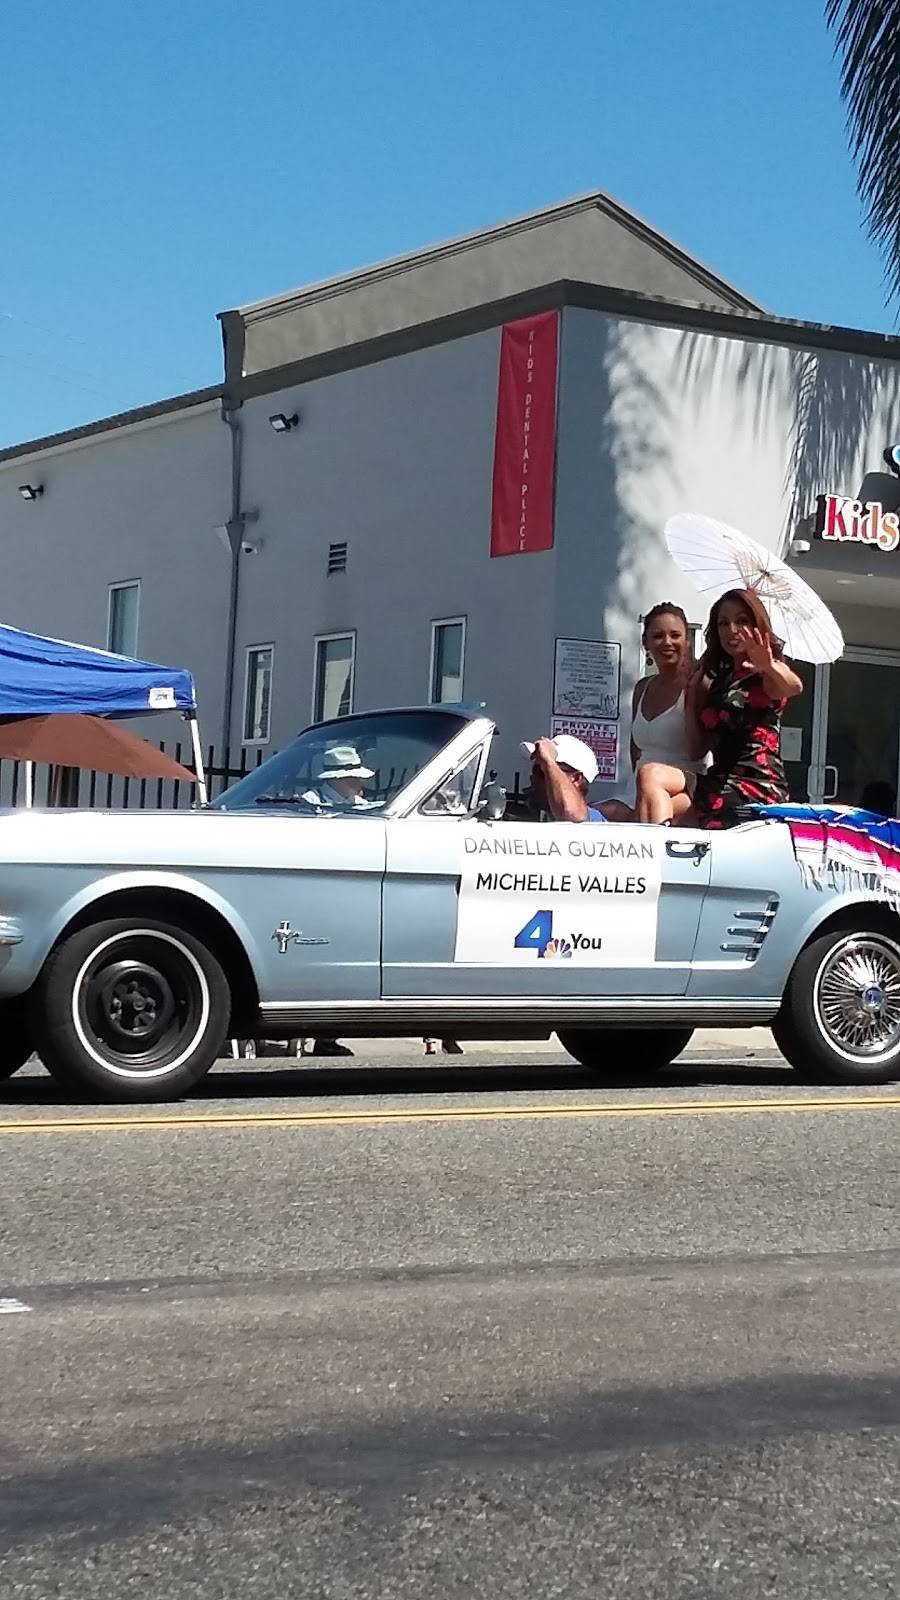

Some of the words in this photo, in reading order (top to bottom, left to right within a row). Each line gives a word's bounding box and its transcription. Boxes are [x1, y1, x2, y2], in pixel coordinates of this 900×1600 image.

[527, 330, 535, 383] KIDS
[523, 393, 532, 474] DENTAL
[519, 484, 528, 550] PLACE
[822, 494, 899, 551] Kids
[555, 727, 616, 738] PROPERTY
[561, 720, 608, 731] PRIVATE
[464, 837, 562, 857] DANIELLA
[568, 841, 654, 859] GUZMAN
[476, 872, 571, 892] MICHELLE
[578, 875, 646, 894] VALLES
[514, 910, 553, 958] 4
[570, 933, 601, 949] You
